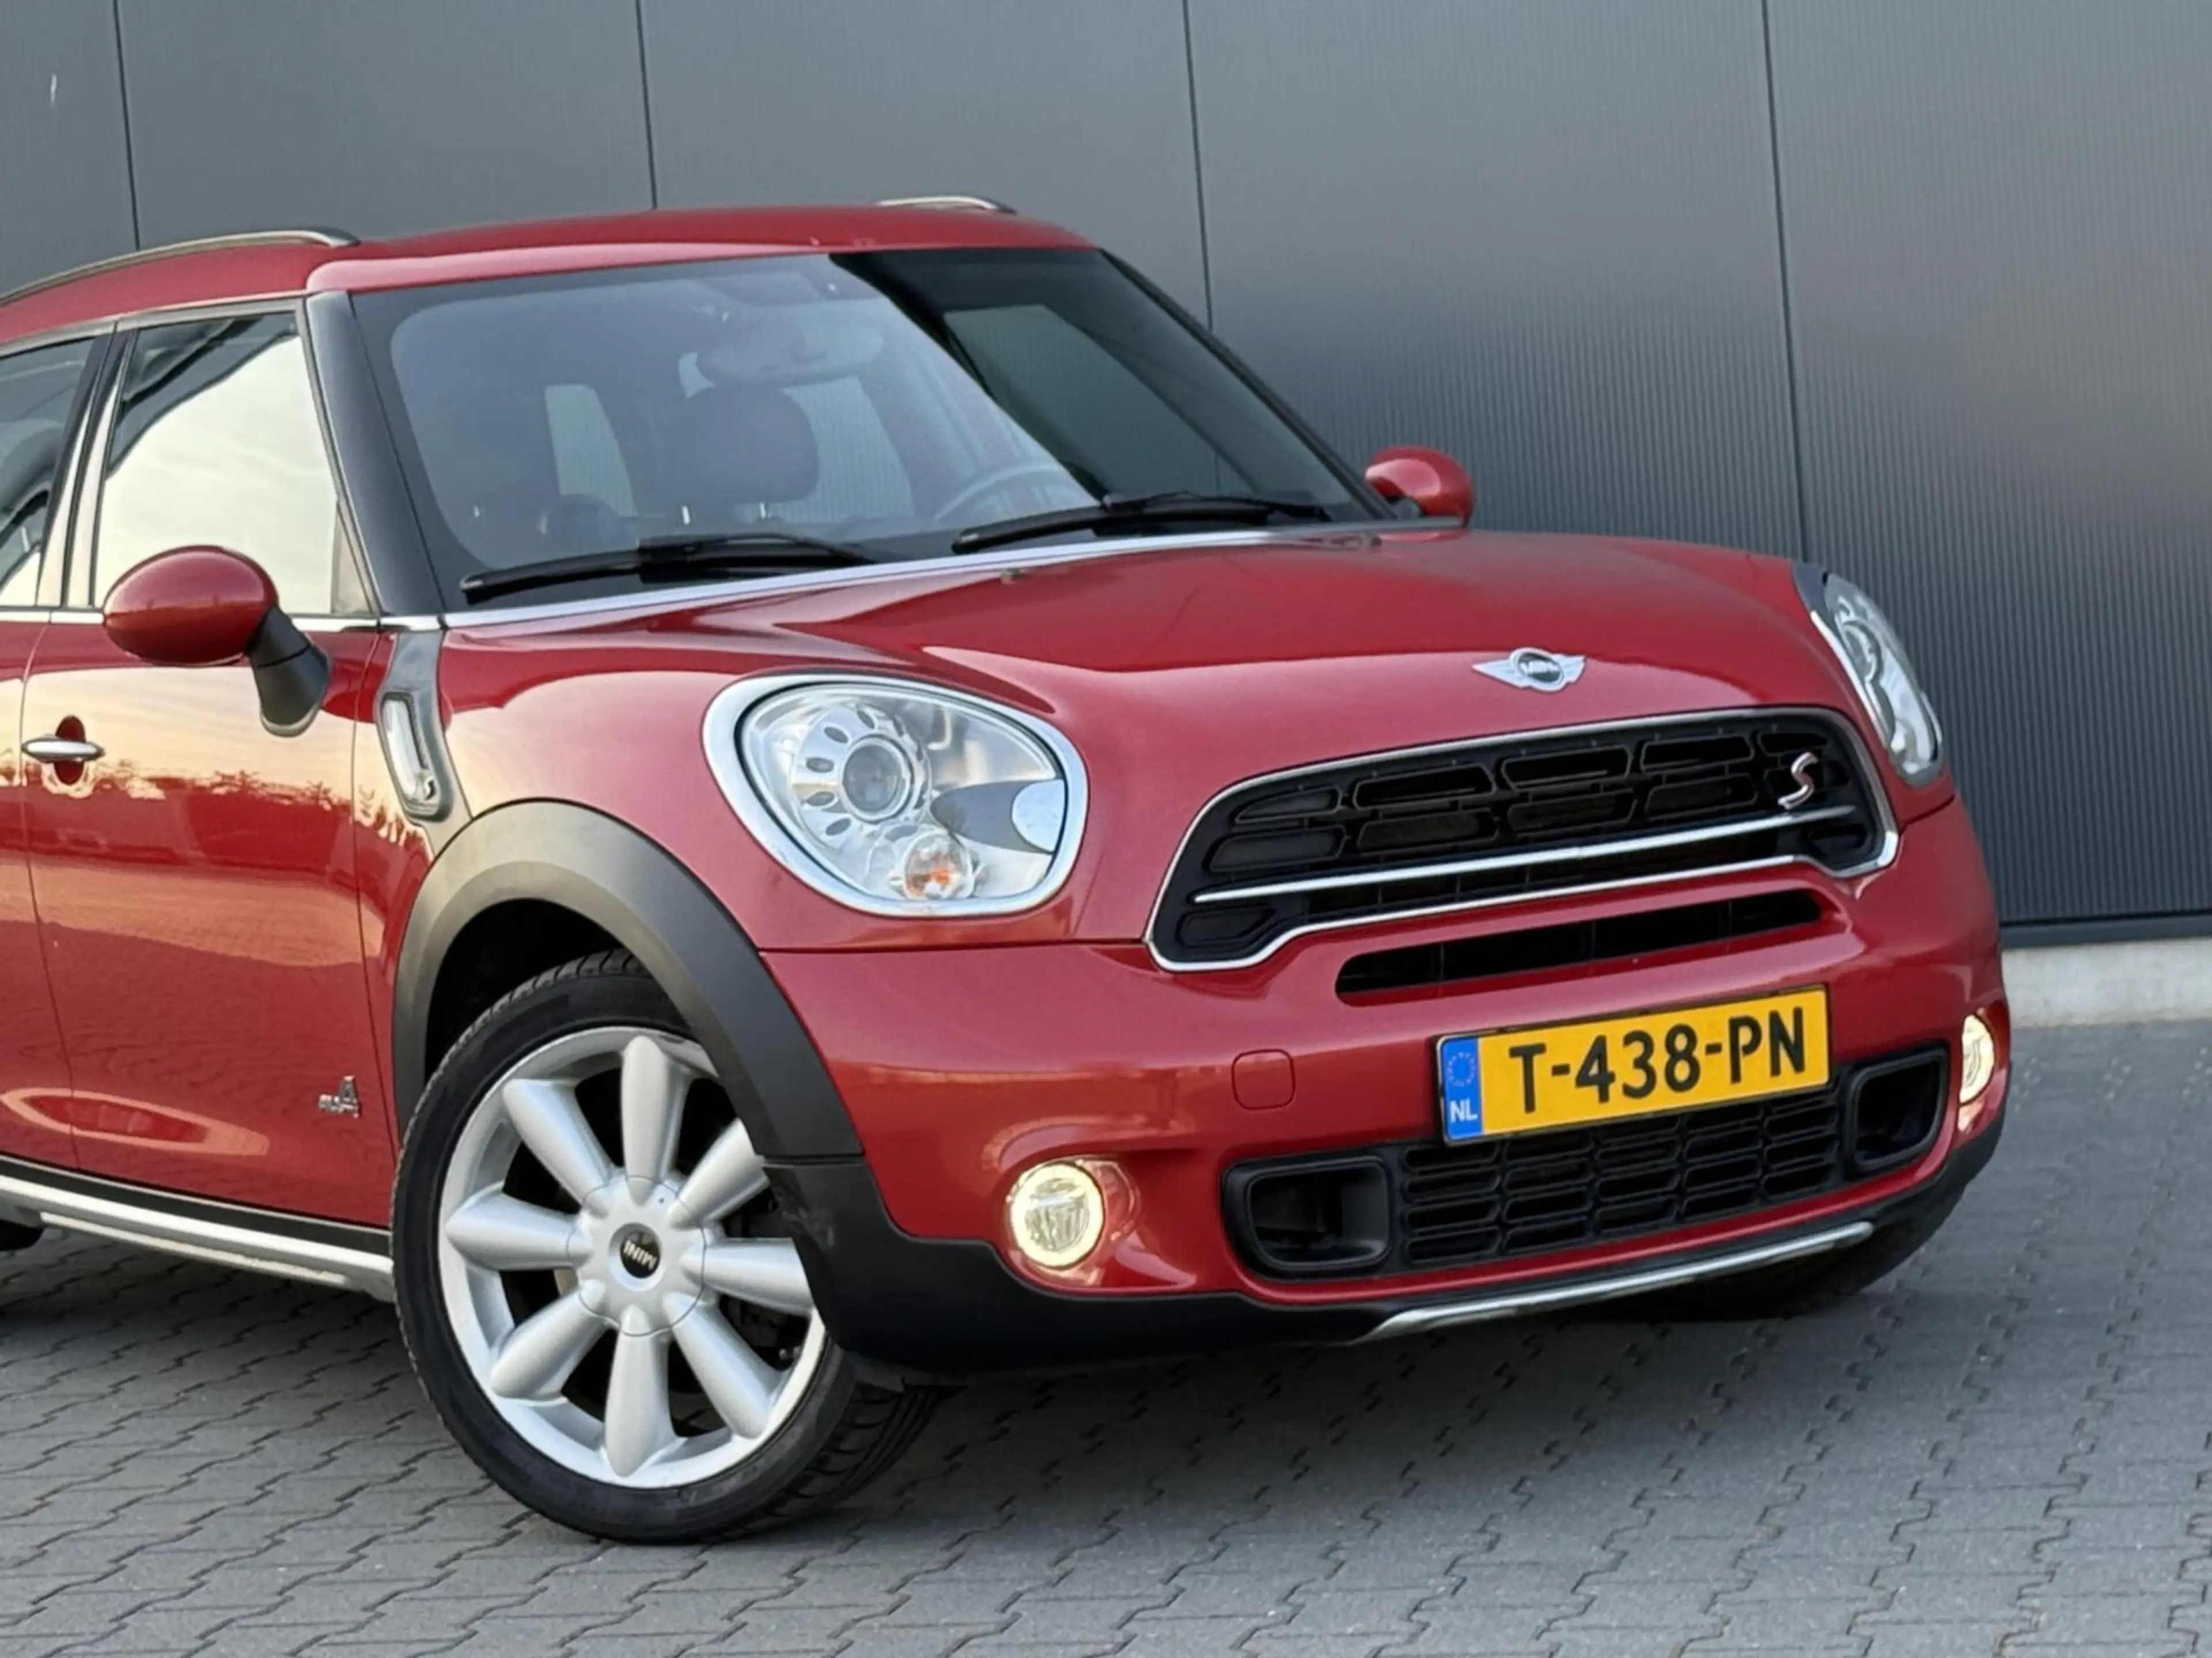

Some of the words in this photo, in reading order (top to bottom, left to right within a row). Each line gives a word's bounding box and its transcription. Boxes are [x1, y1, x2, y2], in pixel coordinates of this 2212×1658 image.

[1778, 752, 1819, 809] S
[1509, 1007, 1805, 1113] T-438-PN
[1449, 1099, 1478, 1123] NL
